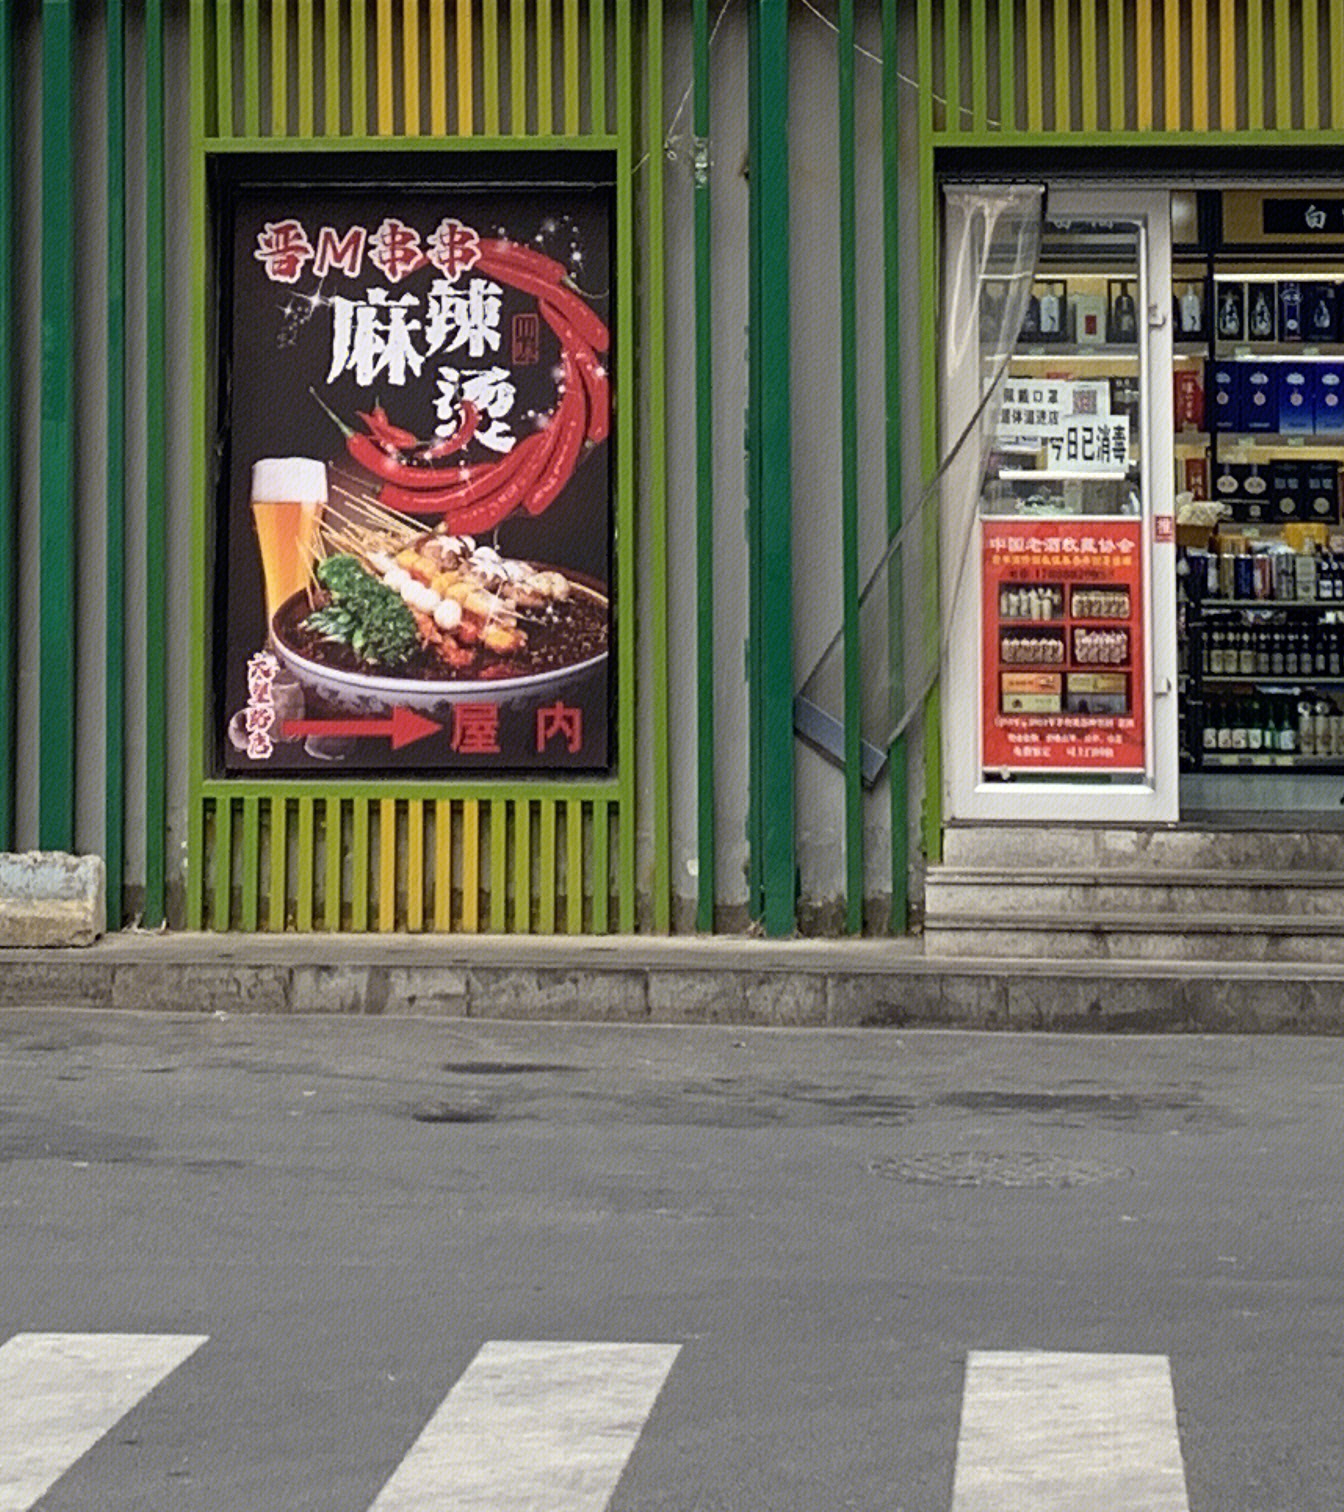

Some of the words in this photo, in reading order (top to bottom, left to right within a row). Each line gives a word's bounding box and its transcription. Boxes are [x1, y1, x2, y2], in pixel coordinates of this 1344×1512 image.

[324, 276, 517, 453] 麻辣烫
[1049, 425, 1127, 464] 今日已消毒
[451, 700, 581, 754] 屋内
